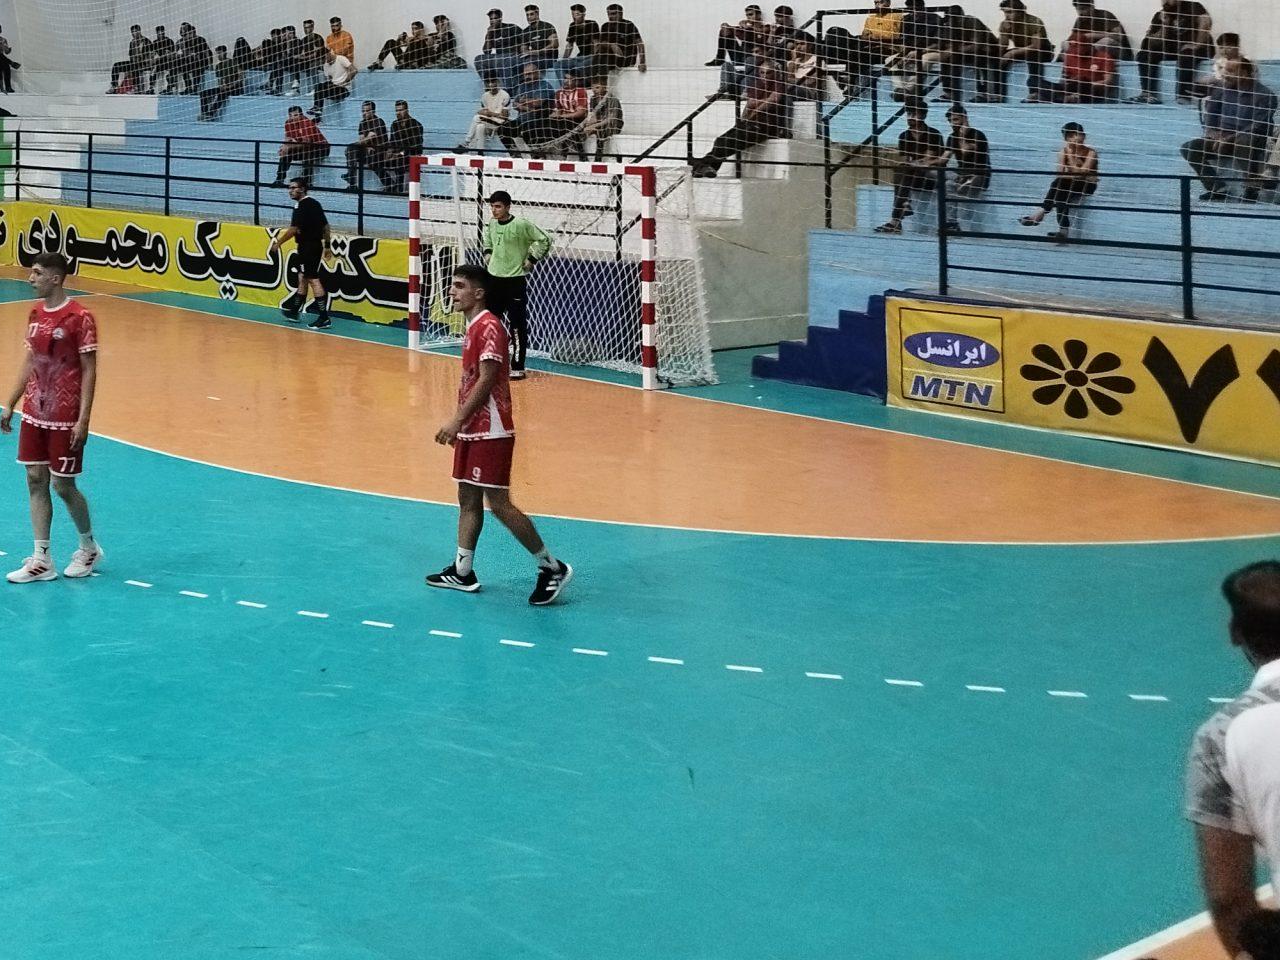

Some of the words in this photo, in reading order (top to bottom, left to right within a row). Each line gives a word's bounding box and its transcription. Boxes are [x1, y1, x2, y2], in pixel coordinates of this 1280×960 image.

[916, 336, 987, 365] ایرانسل
[910, 374, 995, 407] MTN
[58, 456, 76, 473] 77
